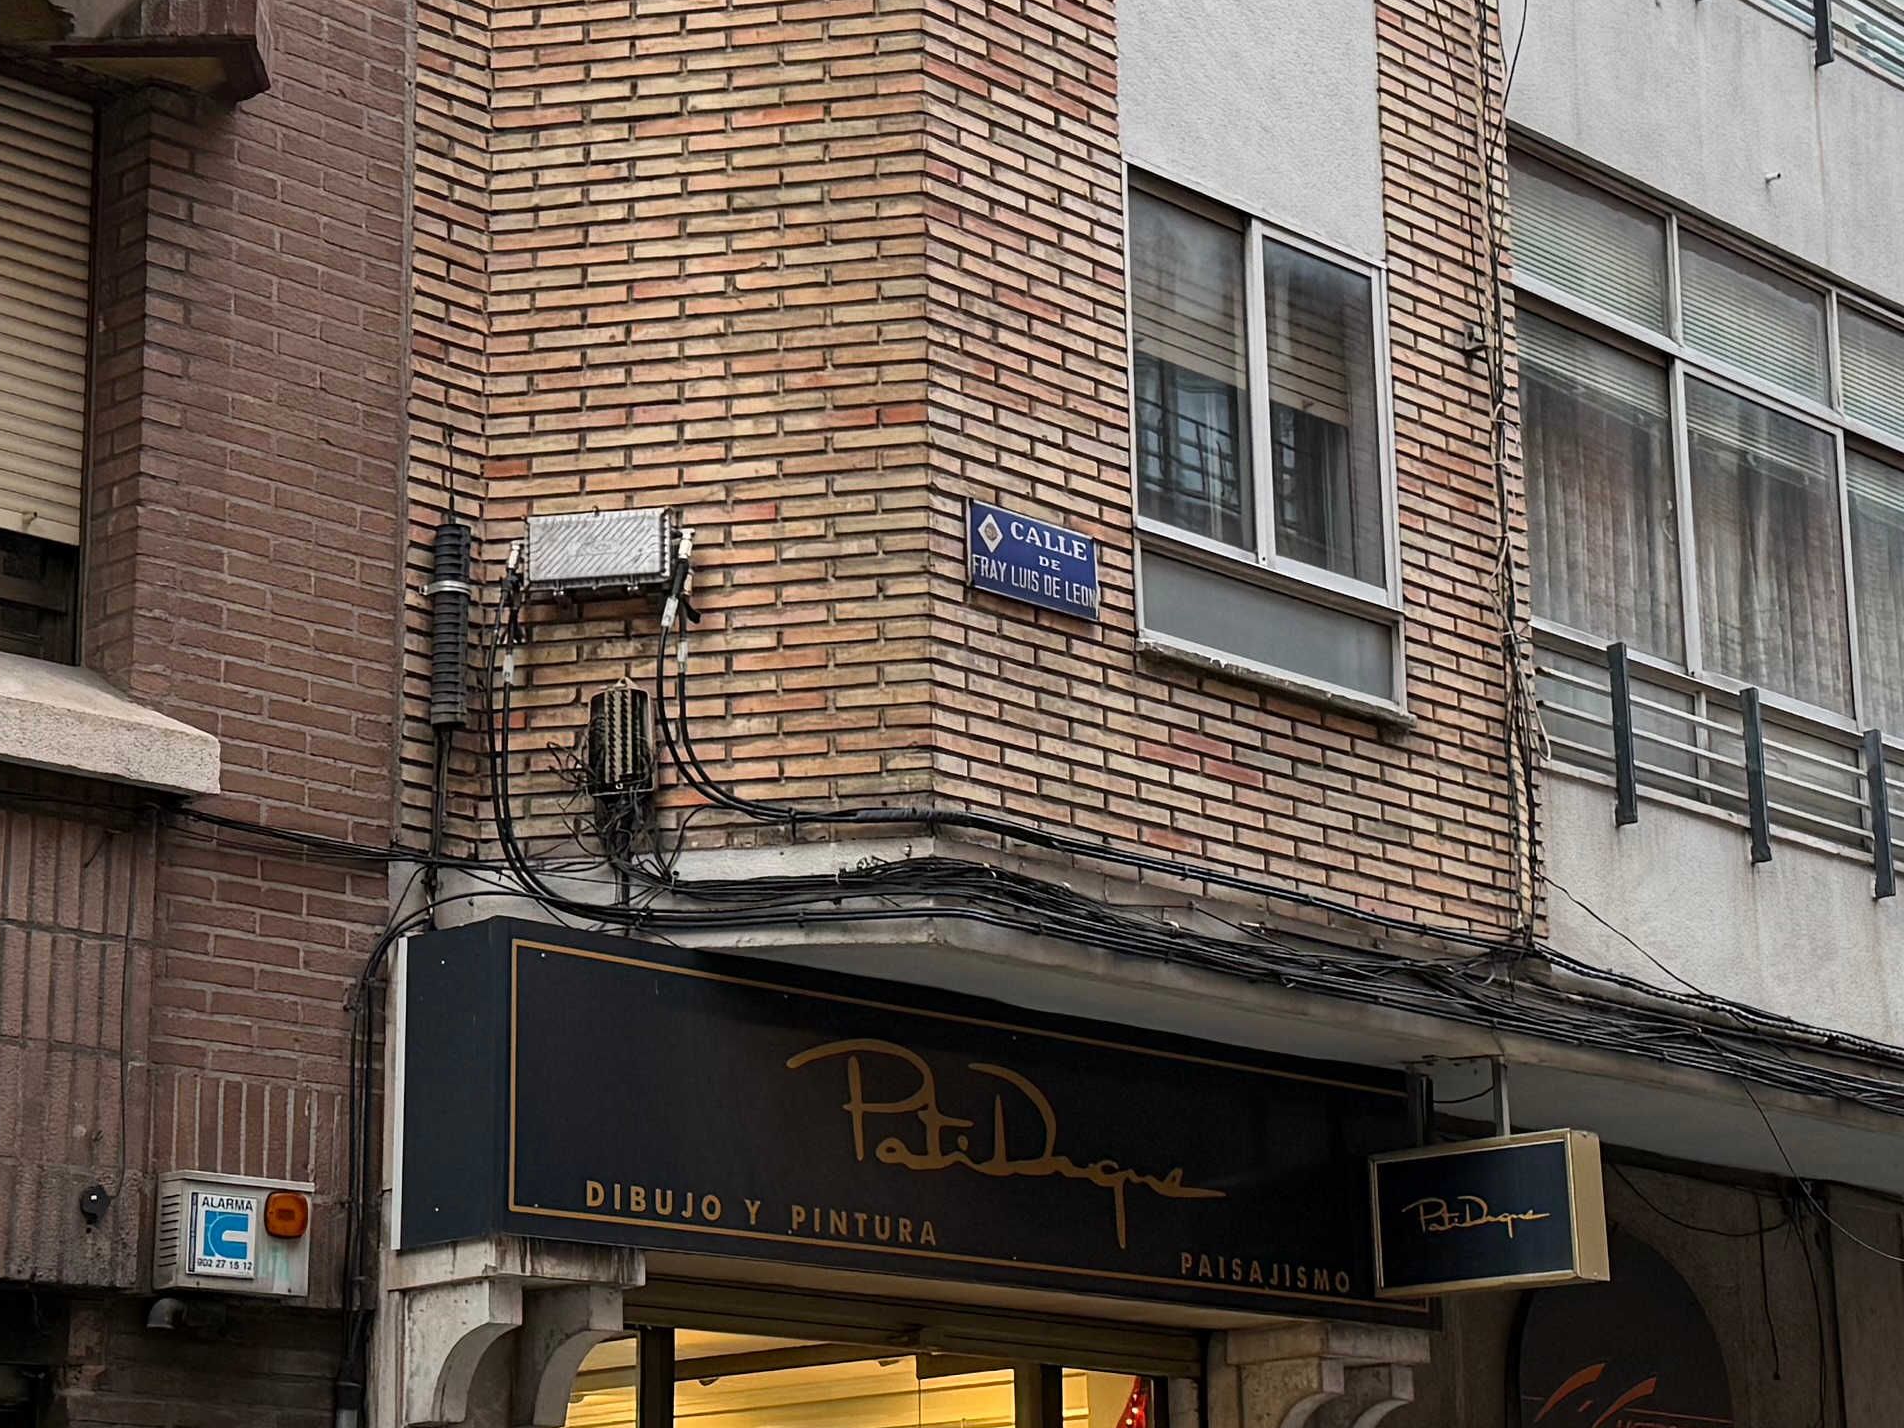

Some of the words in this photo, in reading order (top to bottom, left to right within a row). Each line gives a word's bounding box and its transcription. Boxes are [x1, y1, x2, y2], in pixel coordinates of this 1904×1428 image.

[1010, 521, 1088, 562] CALLE
[972, 553, 1007, 583] FRAY
[1011, 565, 1040, 593] LUIS
[1043, 574, 1061, 599] DE
[1065, 580, 1098, 609] LEON
[1038, 555, 1062, 571] DE
[201, 1196, 253, 1212] ALARMA
[585, 1179, 723, 1221] DIBUJO
[744, 1199, 761, 1225] Y
[790, 1204, 937, 1247] PINTURA
[1180, 1252, 1352, 1295] PAISAJISMO
